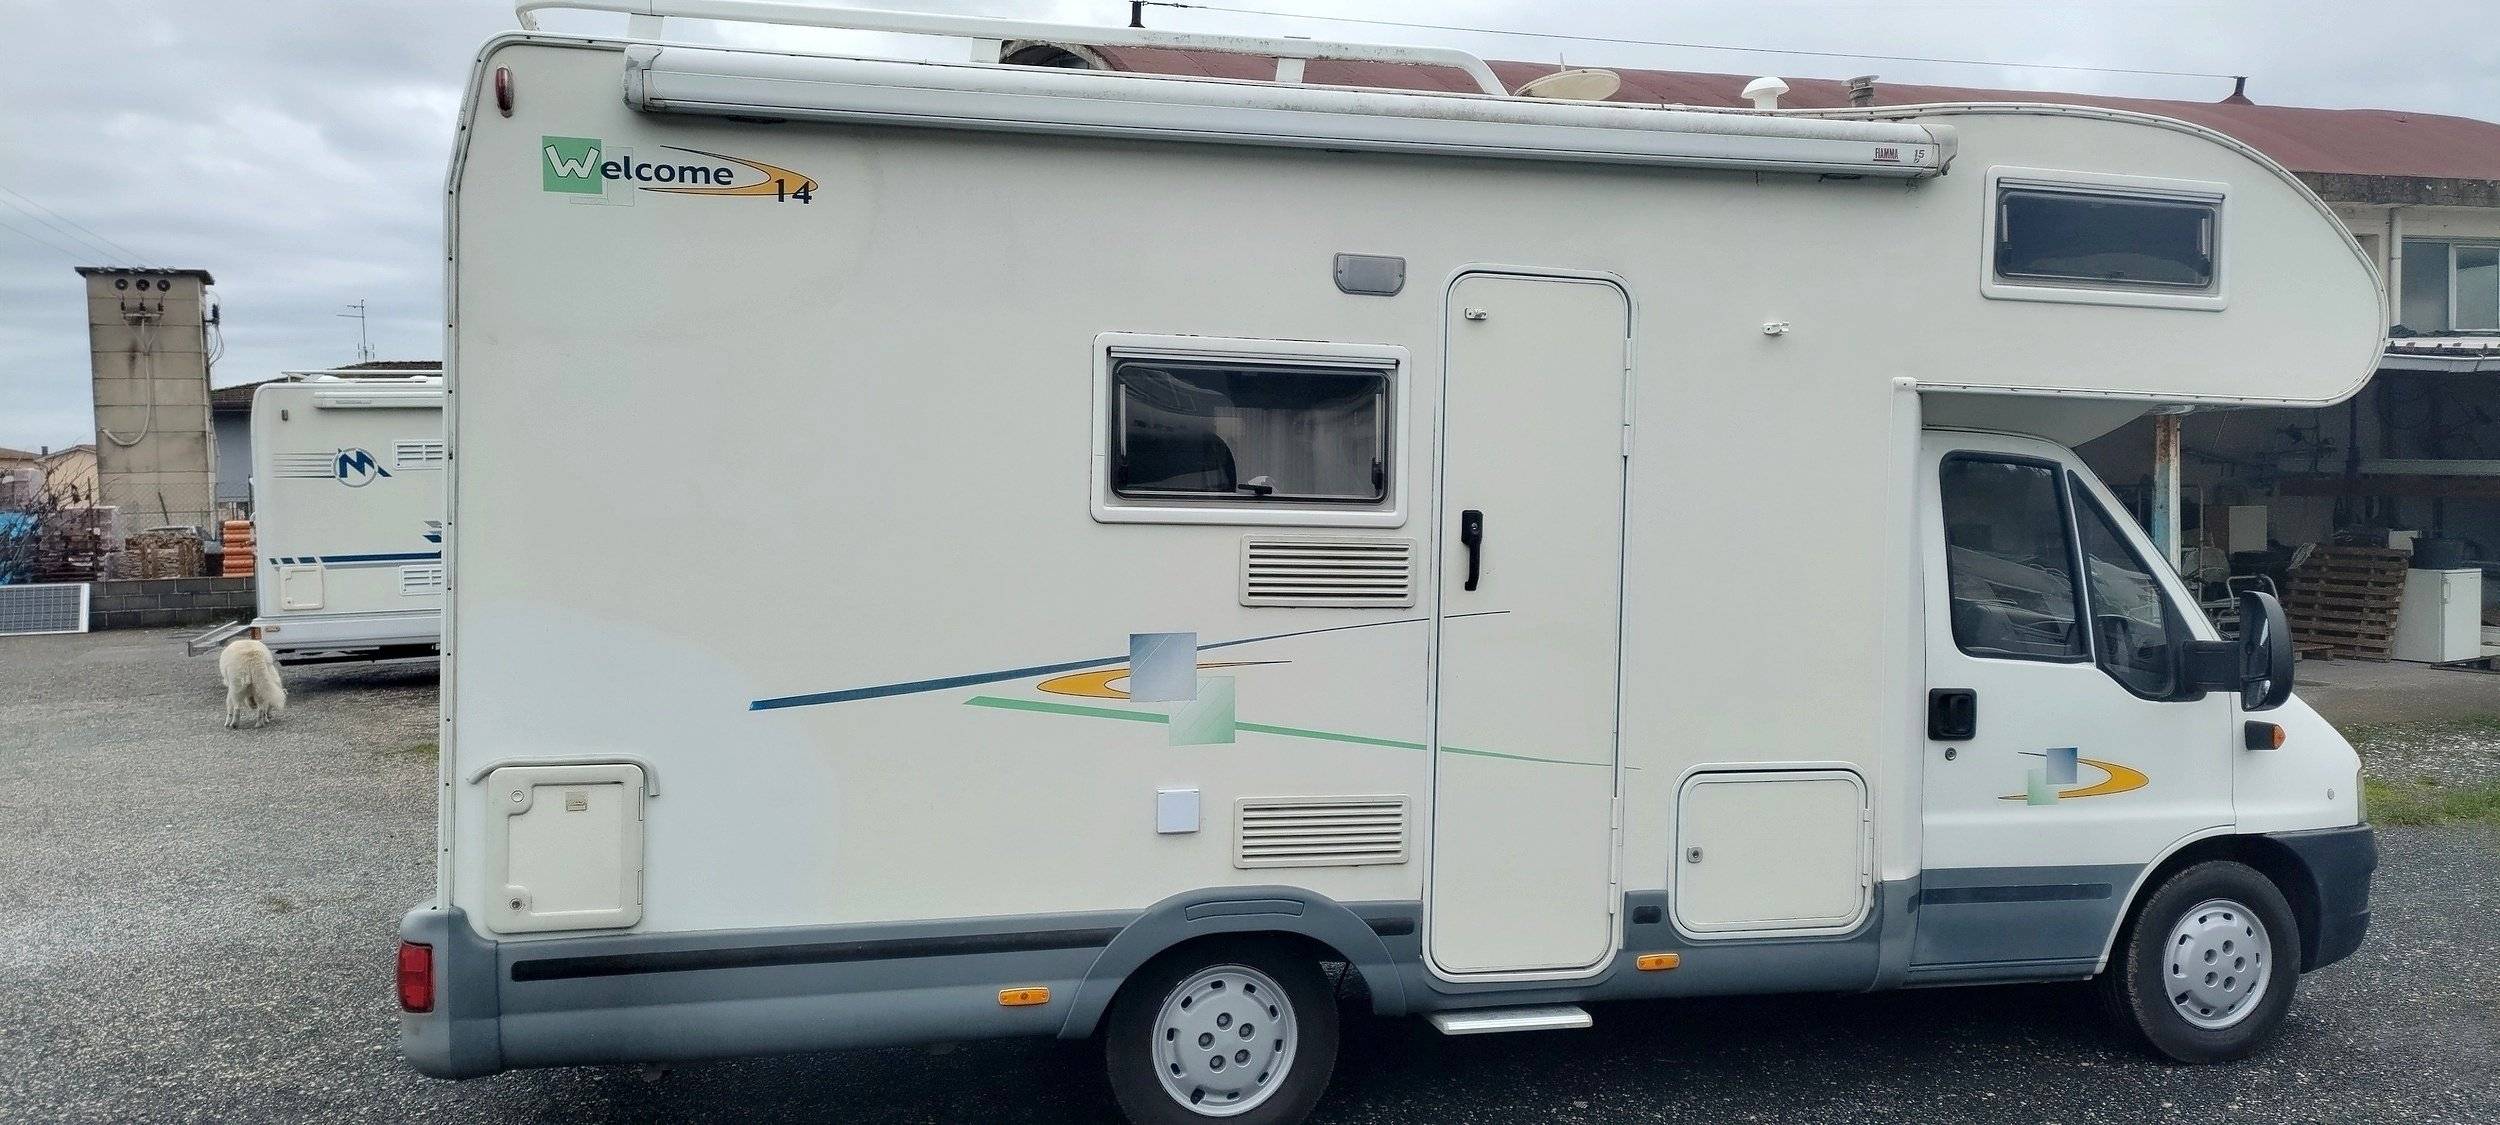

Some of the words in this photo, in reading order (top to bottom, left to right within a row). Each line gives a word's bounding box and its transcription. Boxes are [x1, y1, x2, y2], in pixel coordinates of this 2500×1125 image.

[1875, 148, 1898, 159] FIAMMA
[544, 144, 734, 186] Welcome
[774, 178, 813, 205] 14
